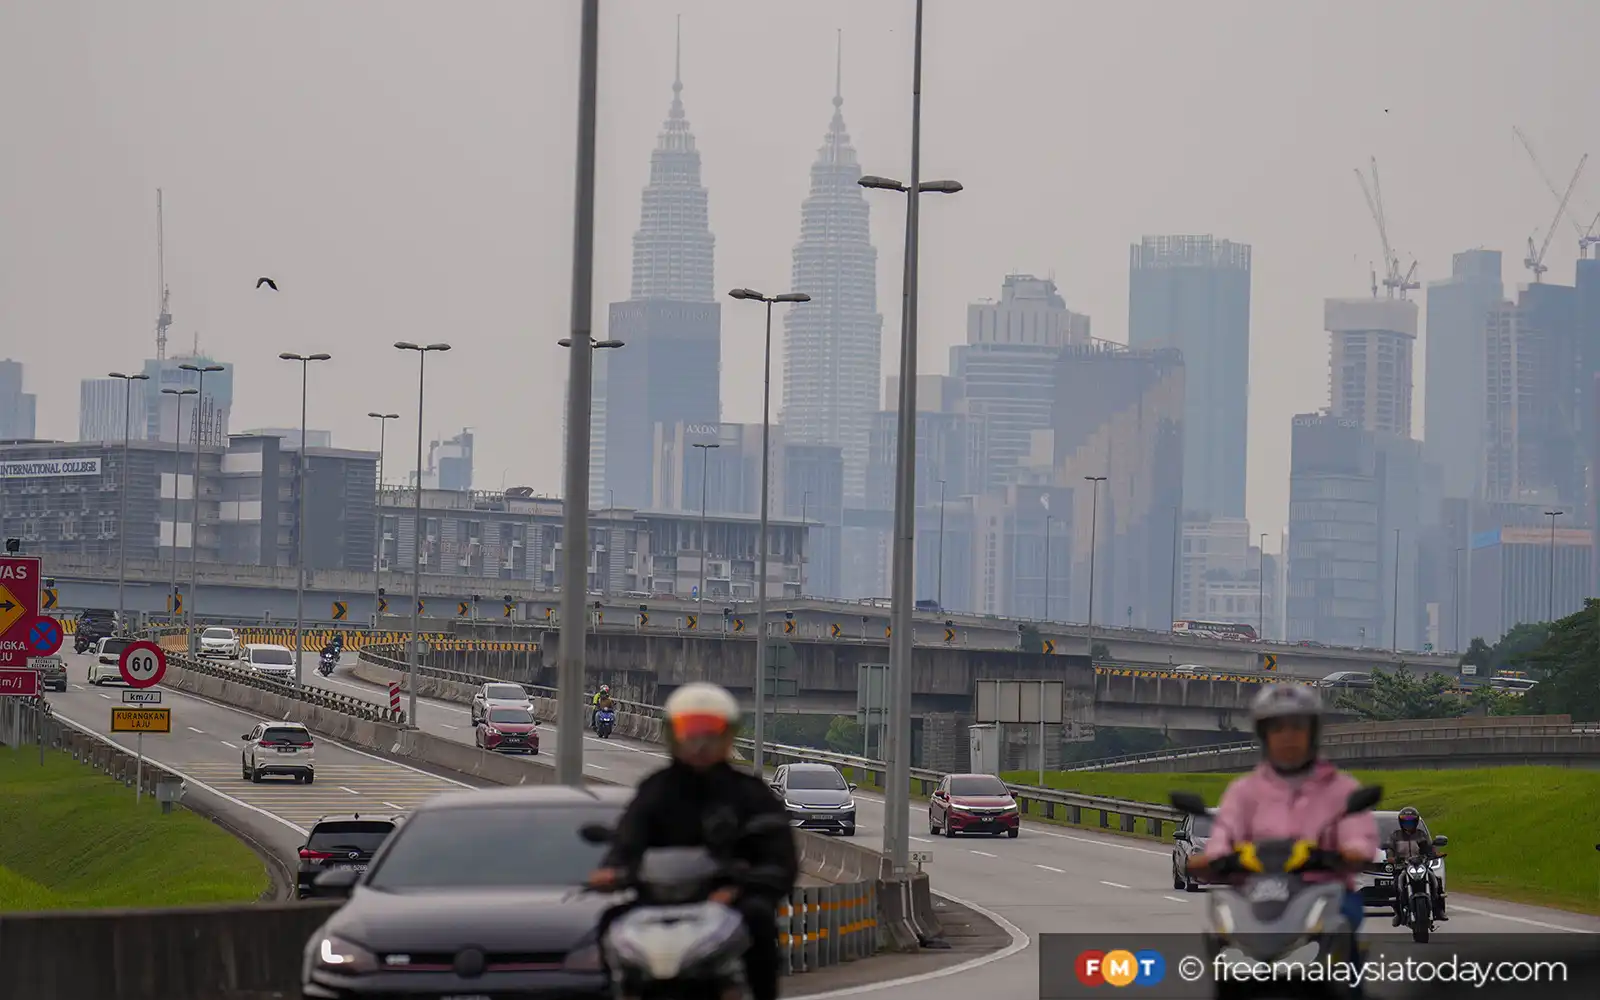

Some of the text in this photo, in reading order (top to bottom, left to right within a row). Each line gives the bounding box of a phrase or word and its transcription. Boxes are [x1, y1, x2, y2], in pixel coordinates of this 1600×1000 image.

[685, 424, 717, 434] AXON
[0, 461, 97, 475] INTERNATIONAL COLLEGE
[132, 656, 153, 672] 60
[0, 677, 22, 688] m/j
[116, 712, 165, 720] KURANGKAN
[131, 720, 151, 728] LAJU
